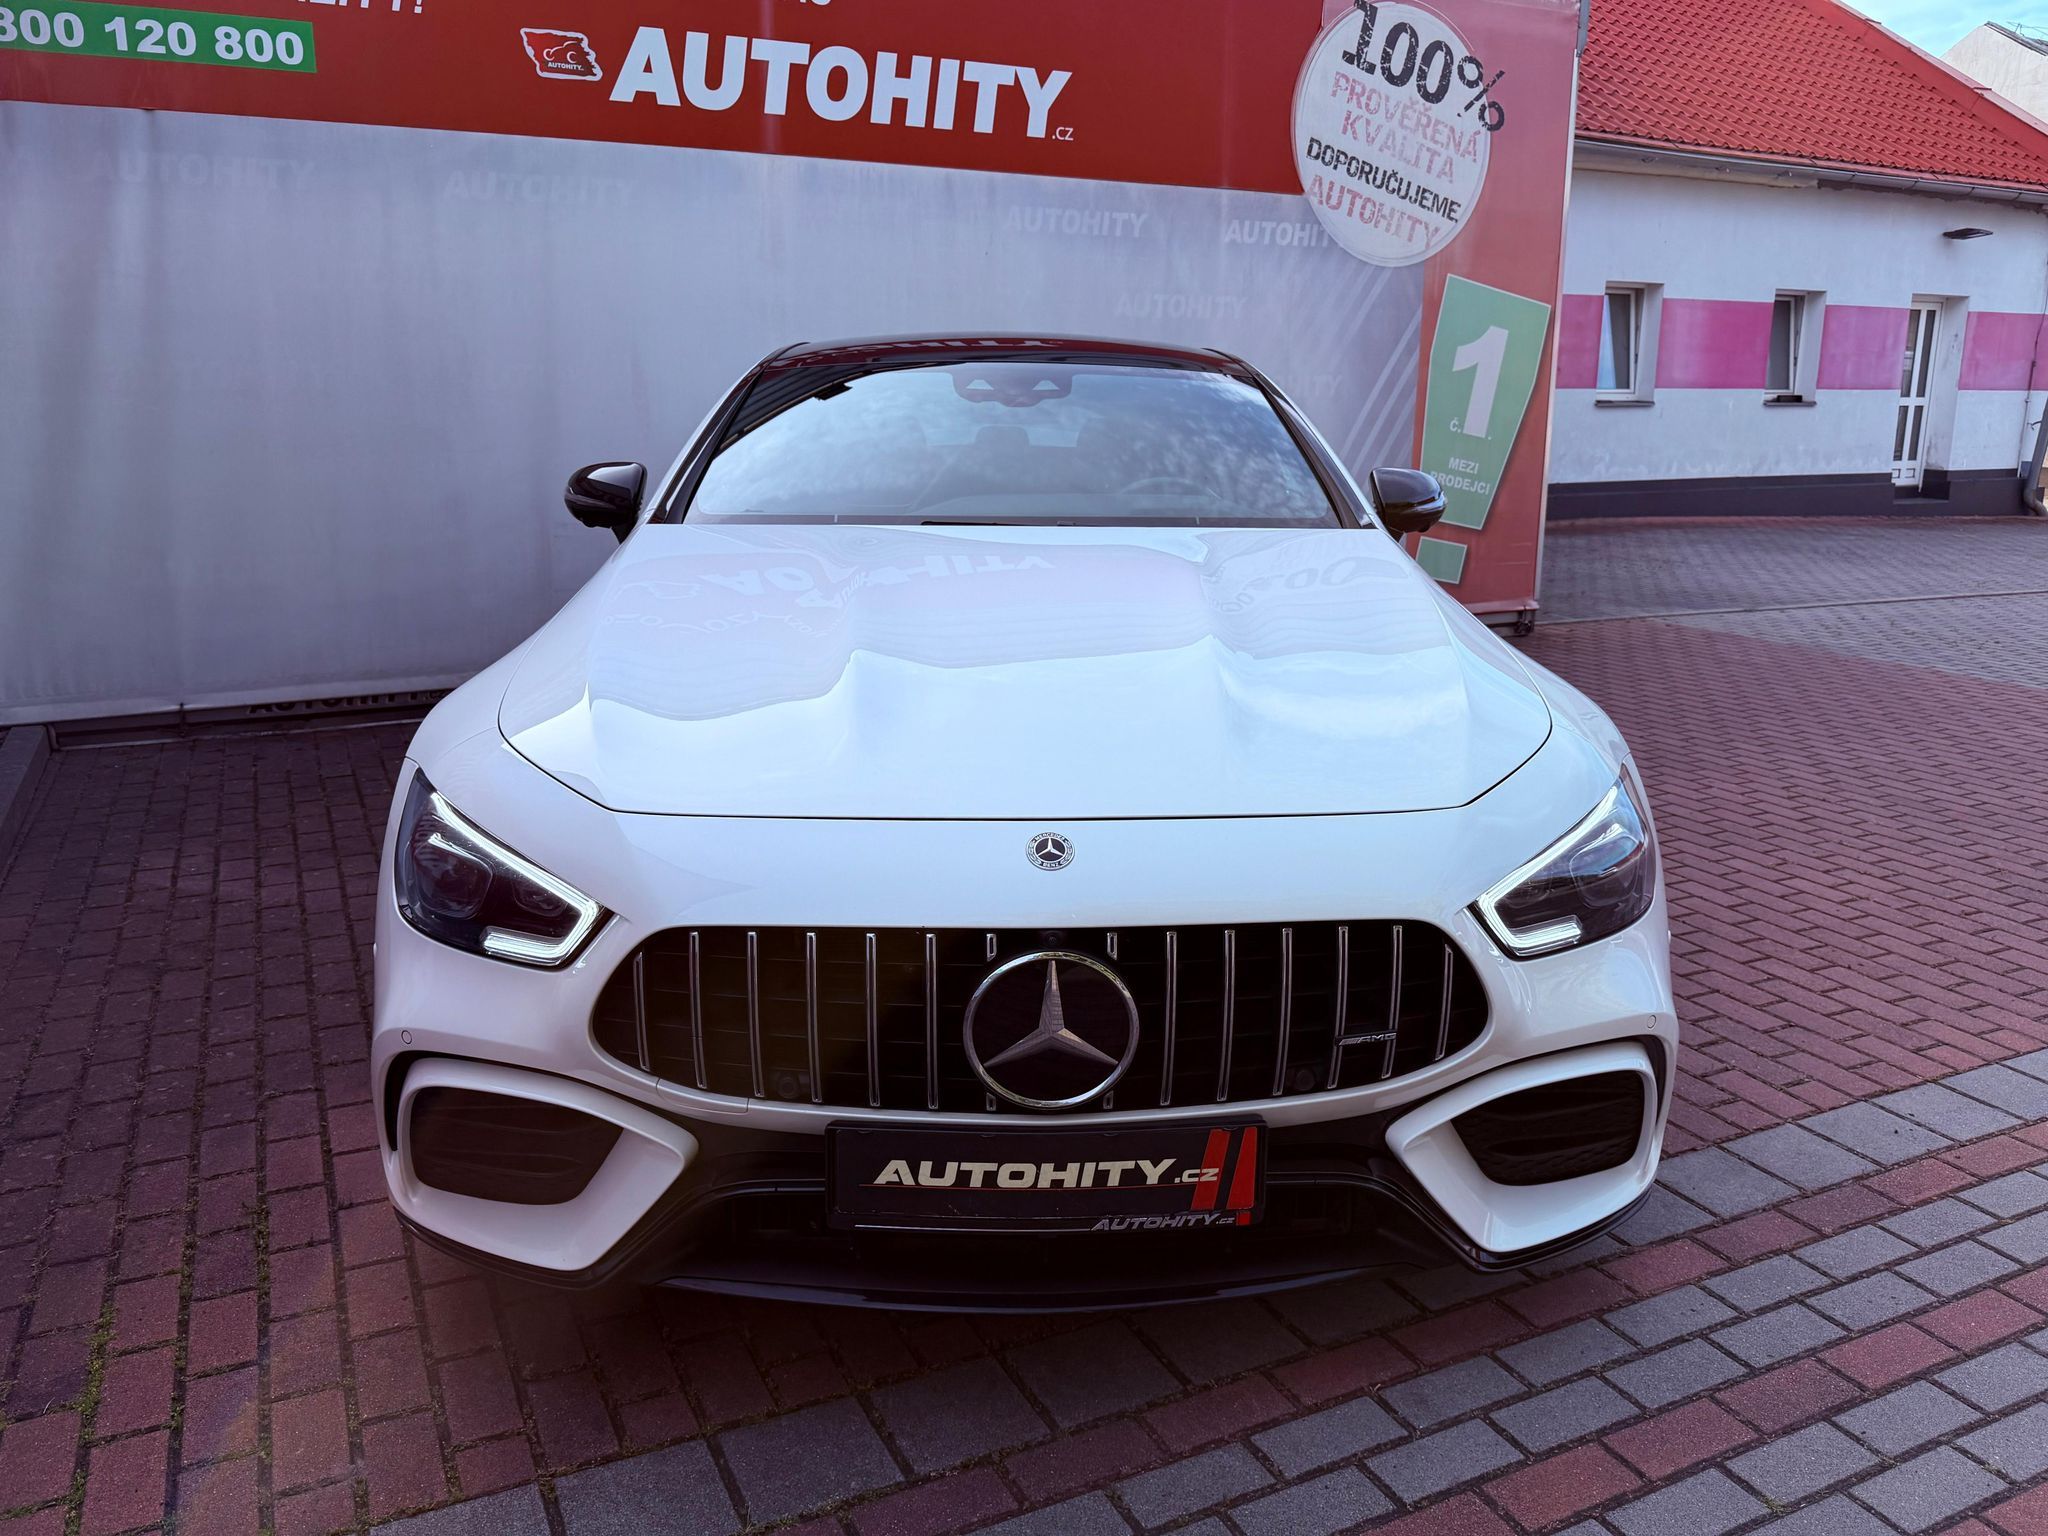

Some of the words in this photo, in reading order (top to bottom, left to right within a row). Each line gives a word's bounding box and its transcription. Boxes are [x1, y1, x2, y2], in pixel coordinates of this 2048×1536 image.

[104, 16, 197, 57] 120
[214, 25, 304, 65] 800
[1341, 0, 1505, 132] 100%
[1341, 110, 1454, 184] KVALITA
[1306, 137, 1462, 223] DOPORUČUJEME
[1007, 205, 1149, 238] AUTOHITY
[1307, 175, 1442, 250] AUTOHITY
[1115, 292, 1248, 320] AUTOHITY
[1430, 471, 1490, 495] PRODEJCI
[1449, 456, 1479, 474] MEZI
